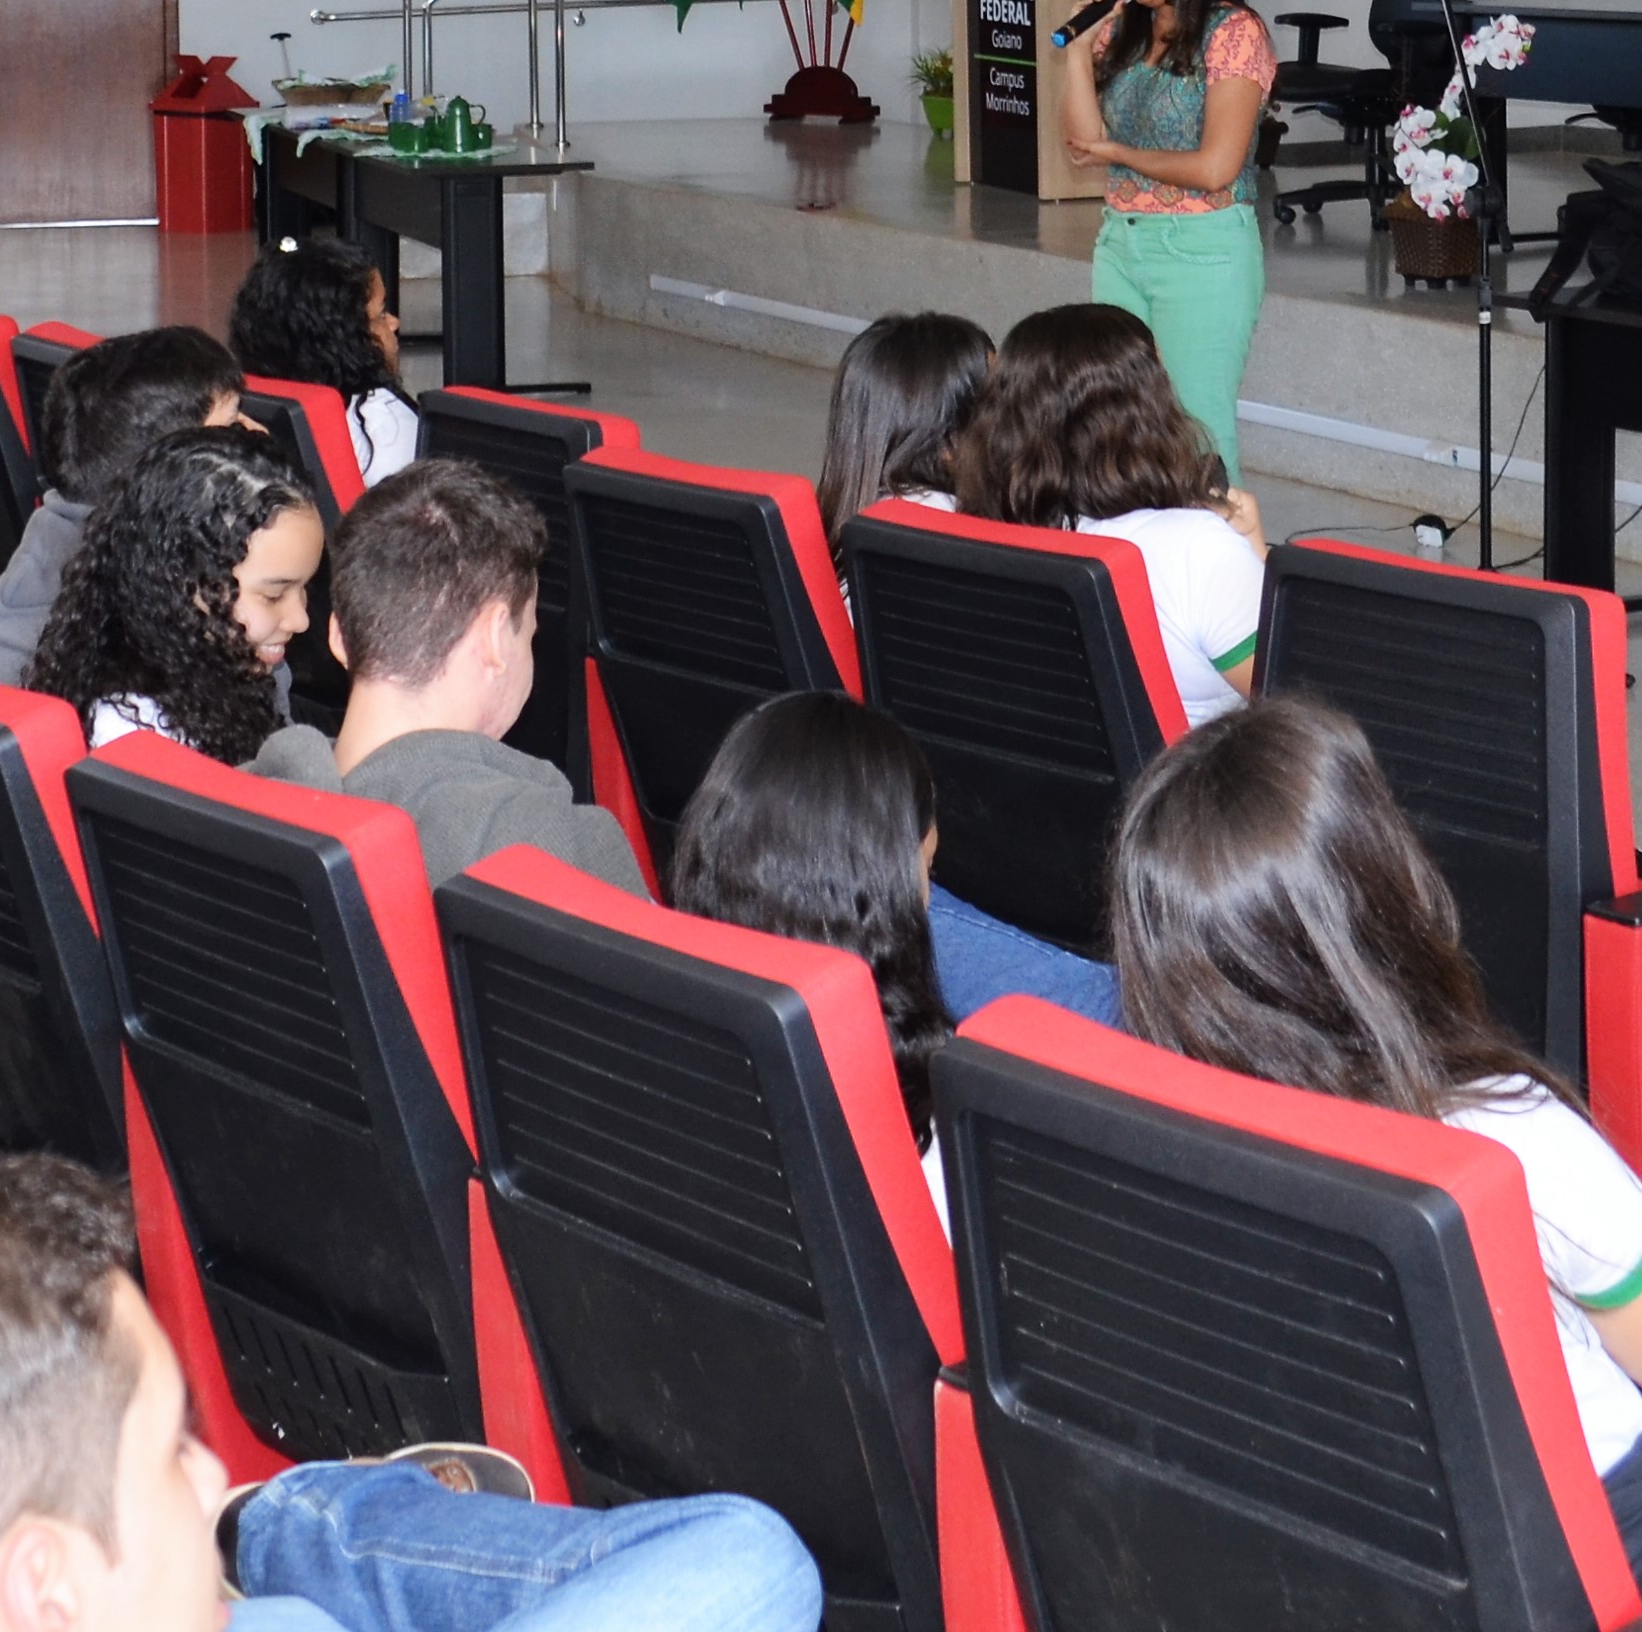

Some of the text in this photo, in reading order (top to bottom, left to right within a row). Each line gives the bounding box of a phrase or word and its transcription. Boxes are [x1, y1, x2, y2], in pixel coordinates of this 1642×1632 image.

[992, 29, 1022, 51] Goiano
[989, 67, 1025, 92] Campus
[986, 92, 1030, 117] Morrinhos
